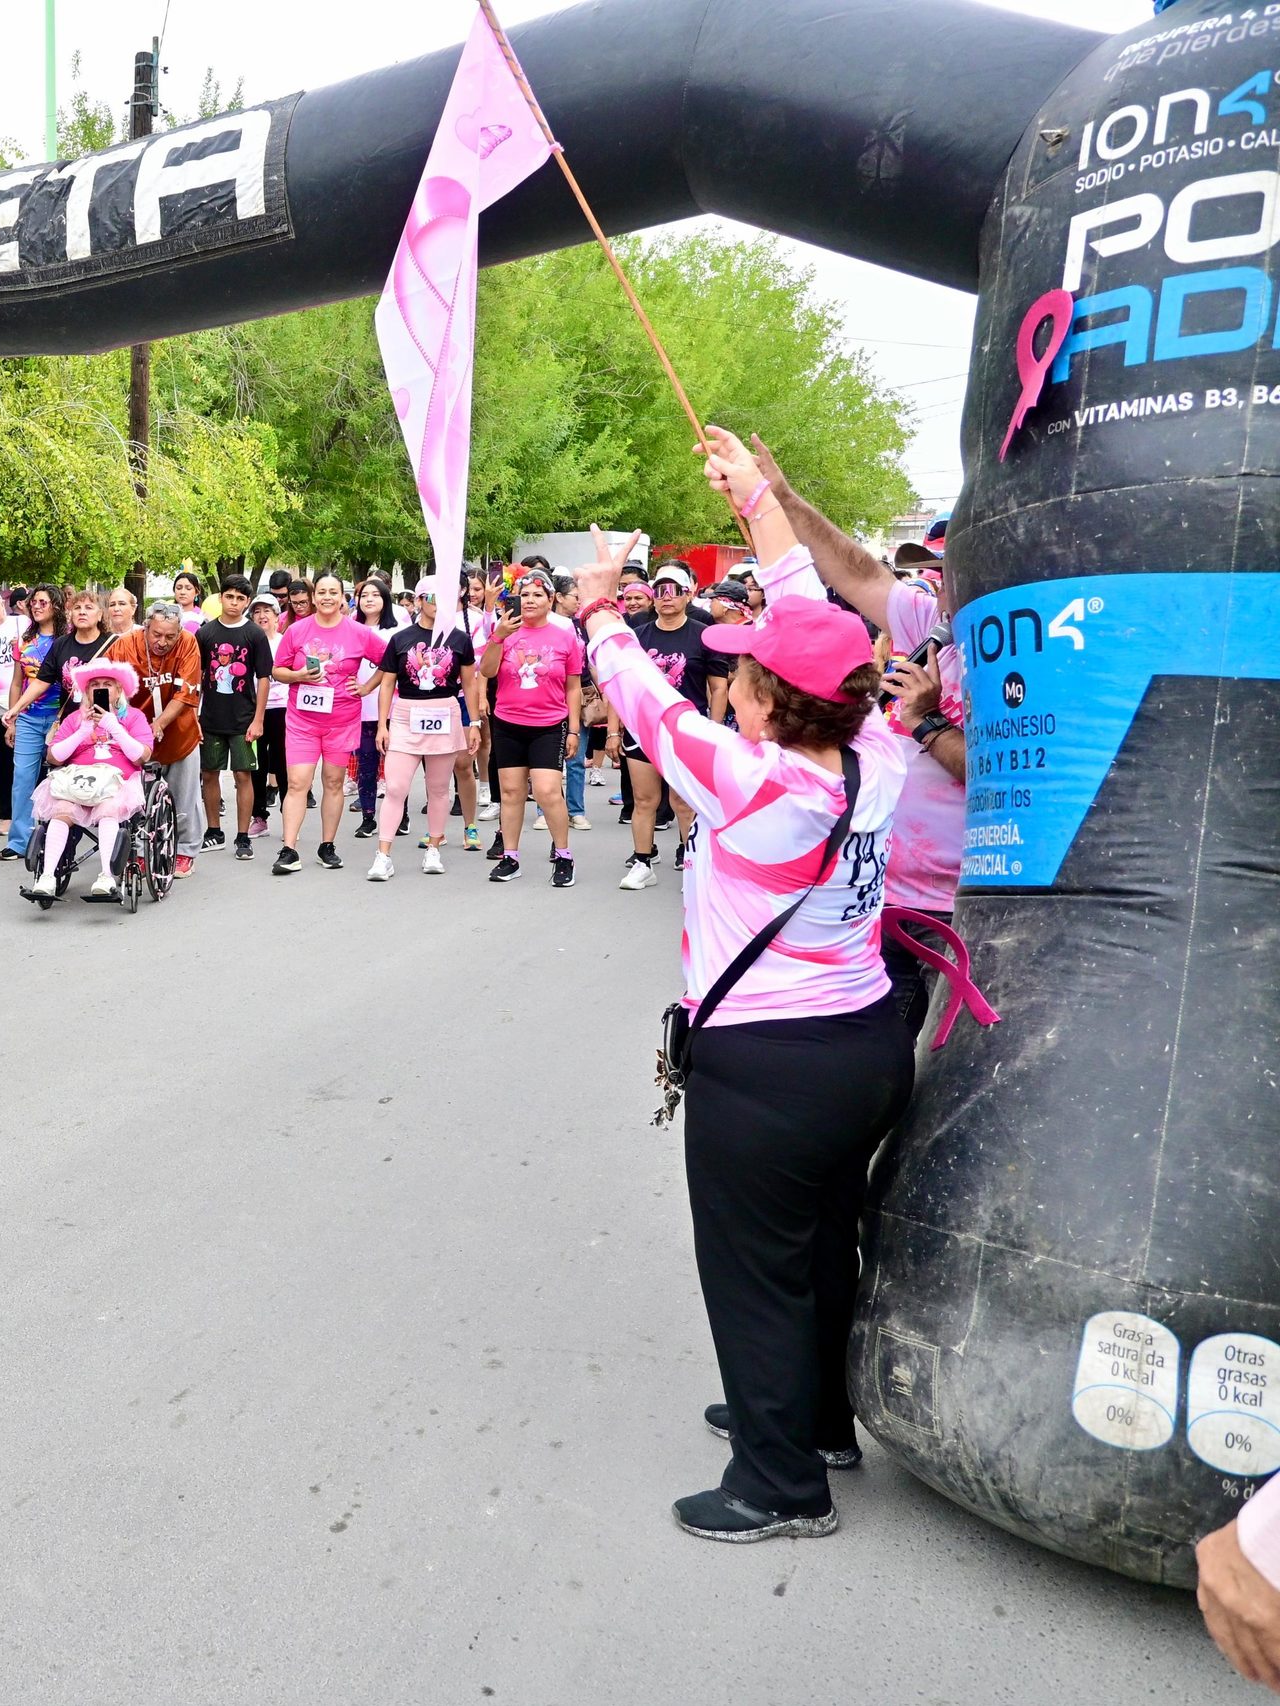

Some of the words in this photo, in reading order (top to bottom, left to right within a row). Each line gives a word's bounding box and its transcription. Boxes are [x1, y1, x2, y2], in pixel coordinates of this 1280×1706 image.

[1103, 46, 1157, 82] que
[1074, 163, 1124, 195] SODIO
[1140, 137, 1223, 173] POTASIO
[1047, 418, 1071, 435] CON
[1074, 391, 1193, 428] VITAMINAS
[1205, 387, 1244, 410] B3,
[142, 672, 173, 688] TEXAS
[303, 694, 324, 706] 021
[420, 719, 442, 730] 120
[986, 713, 1056, 742] MAGNESIO
[979, 753, 992, 776] B6
[996, 751, 1004, 773] Y
[1010, 747, 1046, 771] B12
[1011, 784, 1031, 808] los
[978, 818, 1024, 847] ENERGÍA.
[1224, 1345, 1265, 1367] Otras
[1111, 1361, 1119, 1377] 0
[1123, 1363, 1154, 1386] kcal
[1217, 1367, 1267, 1388] grasas
[1218, 1385, 1228, 1401] 0
[1233, 1387, 1263, 1407] kcal
[1106, 1405, 1135, 1426] 0%
[1224, 1432, 1252, 1453] 0%
[1222, 1479, 1239, 1498] %
